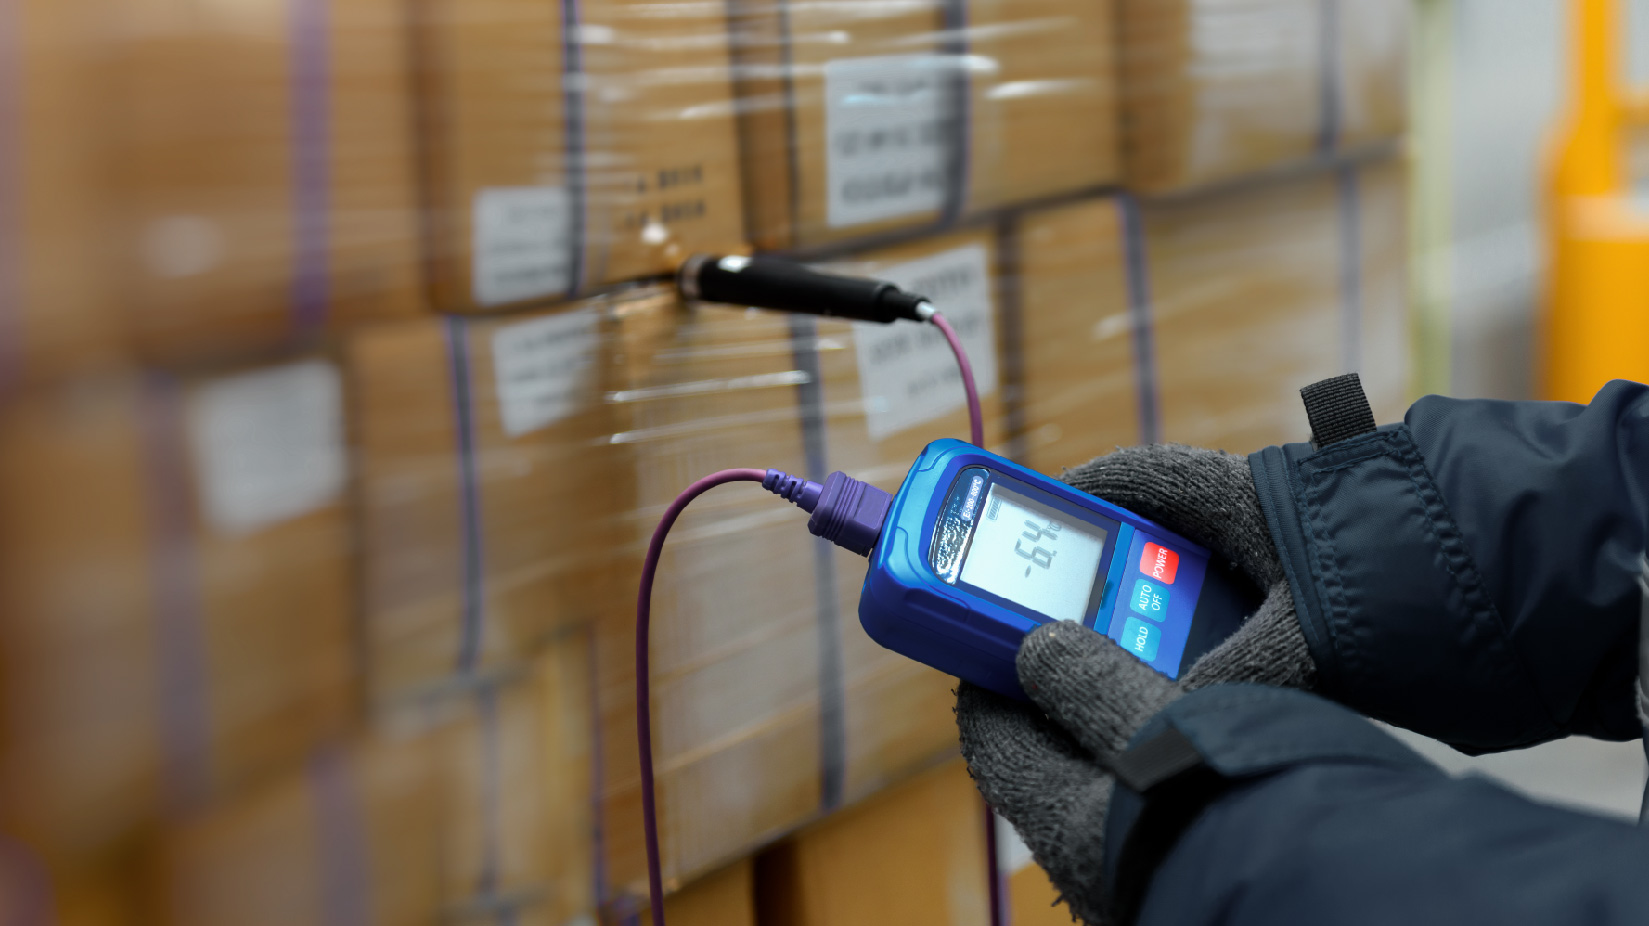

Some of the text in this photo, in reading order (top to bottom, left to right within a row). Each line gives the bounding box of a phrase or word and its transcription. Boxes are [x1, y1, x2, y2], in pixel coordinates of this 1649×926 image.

[1153, 547, 1168, 579] POWER
[1138, 584, 1152, 610] AUTO
[1151, 593, 1163, 611] OFF
[1134, 626, 1149, 652] HOLD
